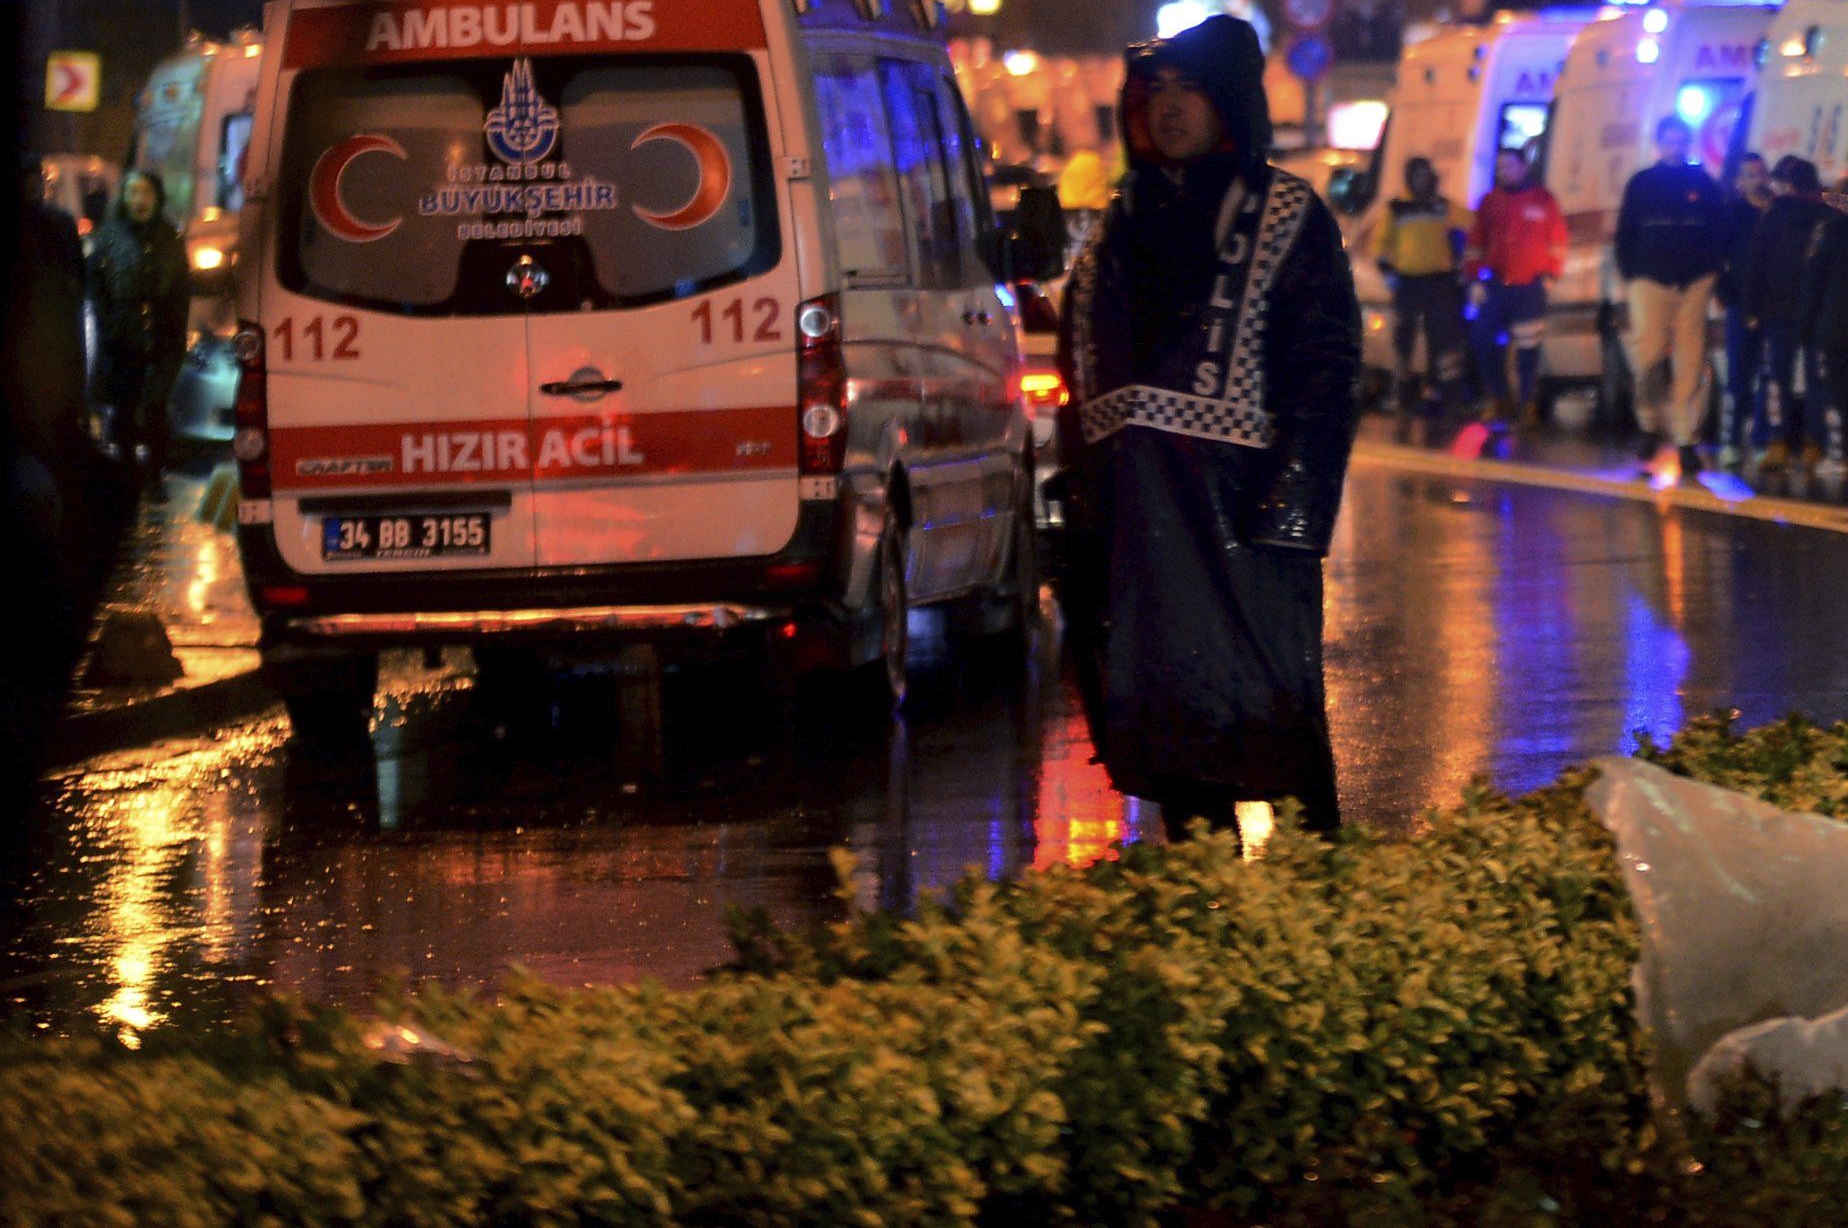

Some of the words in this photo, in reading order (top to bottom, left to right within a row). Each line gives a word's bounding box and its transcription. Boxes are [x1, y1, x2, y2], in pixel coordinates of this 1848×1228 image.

[365, 0, 656, 51] AMBULANS
[273, 316, 359, 362] 112
[691, 297, 782, 343] 112
[401, 431, 531, 474] HIZIR
[539, 421, 643, 470] ACİL
[340, 520, 370, 551] 34
[379, 518, 412, 549] BB
[422, 516, 485, 547] 3155
